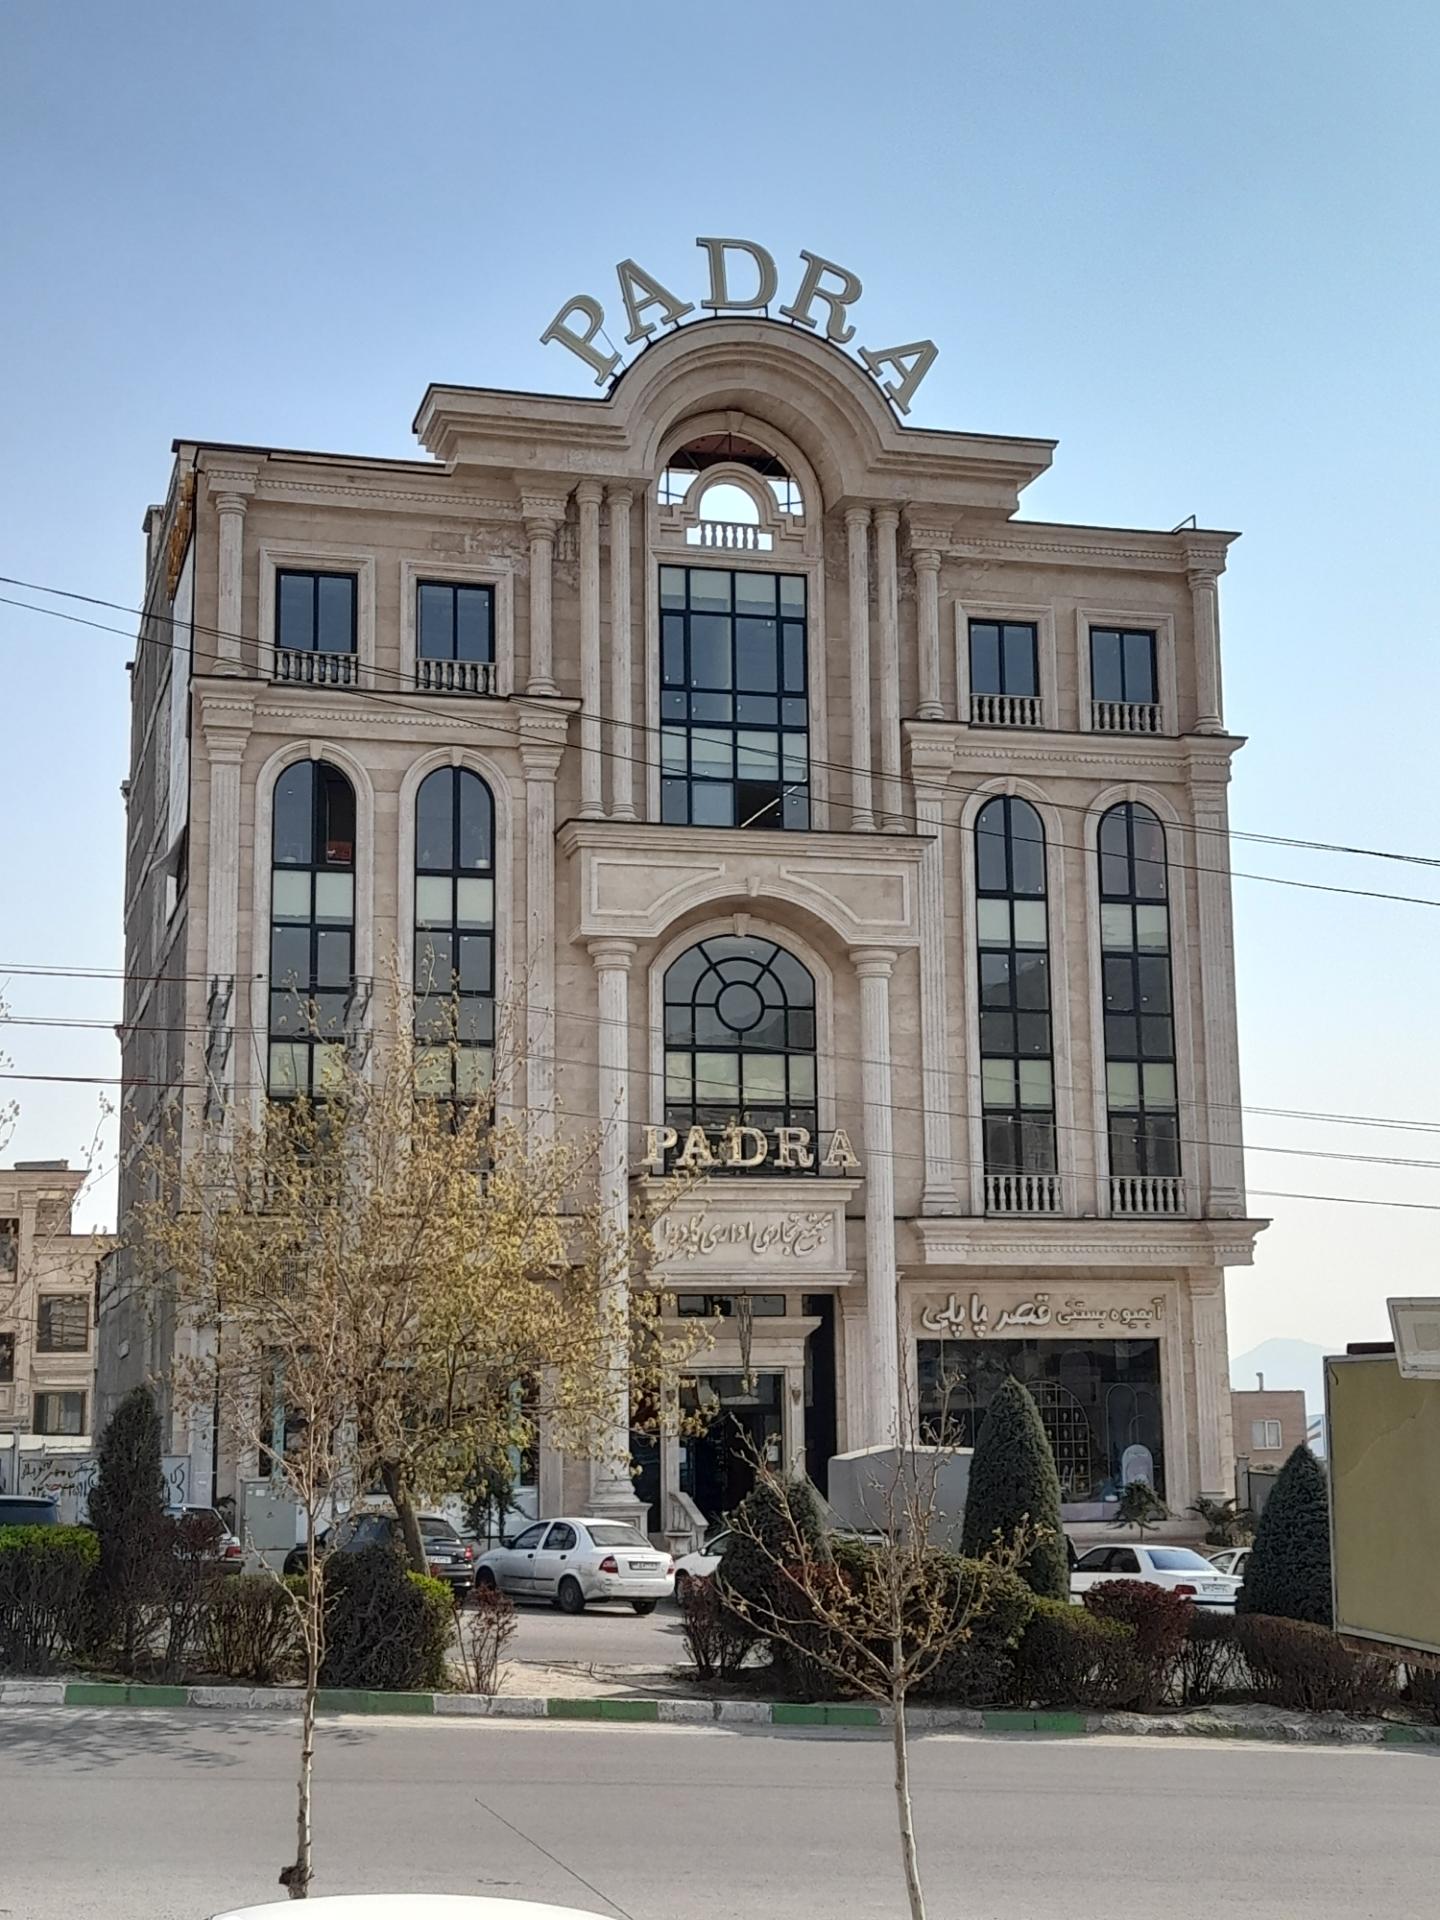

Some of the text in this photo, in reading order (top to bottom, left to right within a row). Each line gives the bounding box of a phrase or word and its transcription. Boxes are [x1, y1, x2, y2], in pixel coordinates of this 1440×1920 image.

[540, 236, 940, 416] PADRA
[640, 1124, 862, 1168] PADRA
[698, 1219, 754, 1254] اداری
[751, 1212, 801, 1256] تجاری
[793, 1212, 834, 1257] مجتمع
[993, 1292, 1052, 1332] قصر
[1056, 1300, 1108, 1329] بستنی
[1109, 1296, 1165, 1329] آبمیوه
